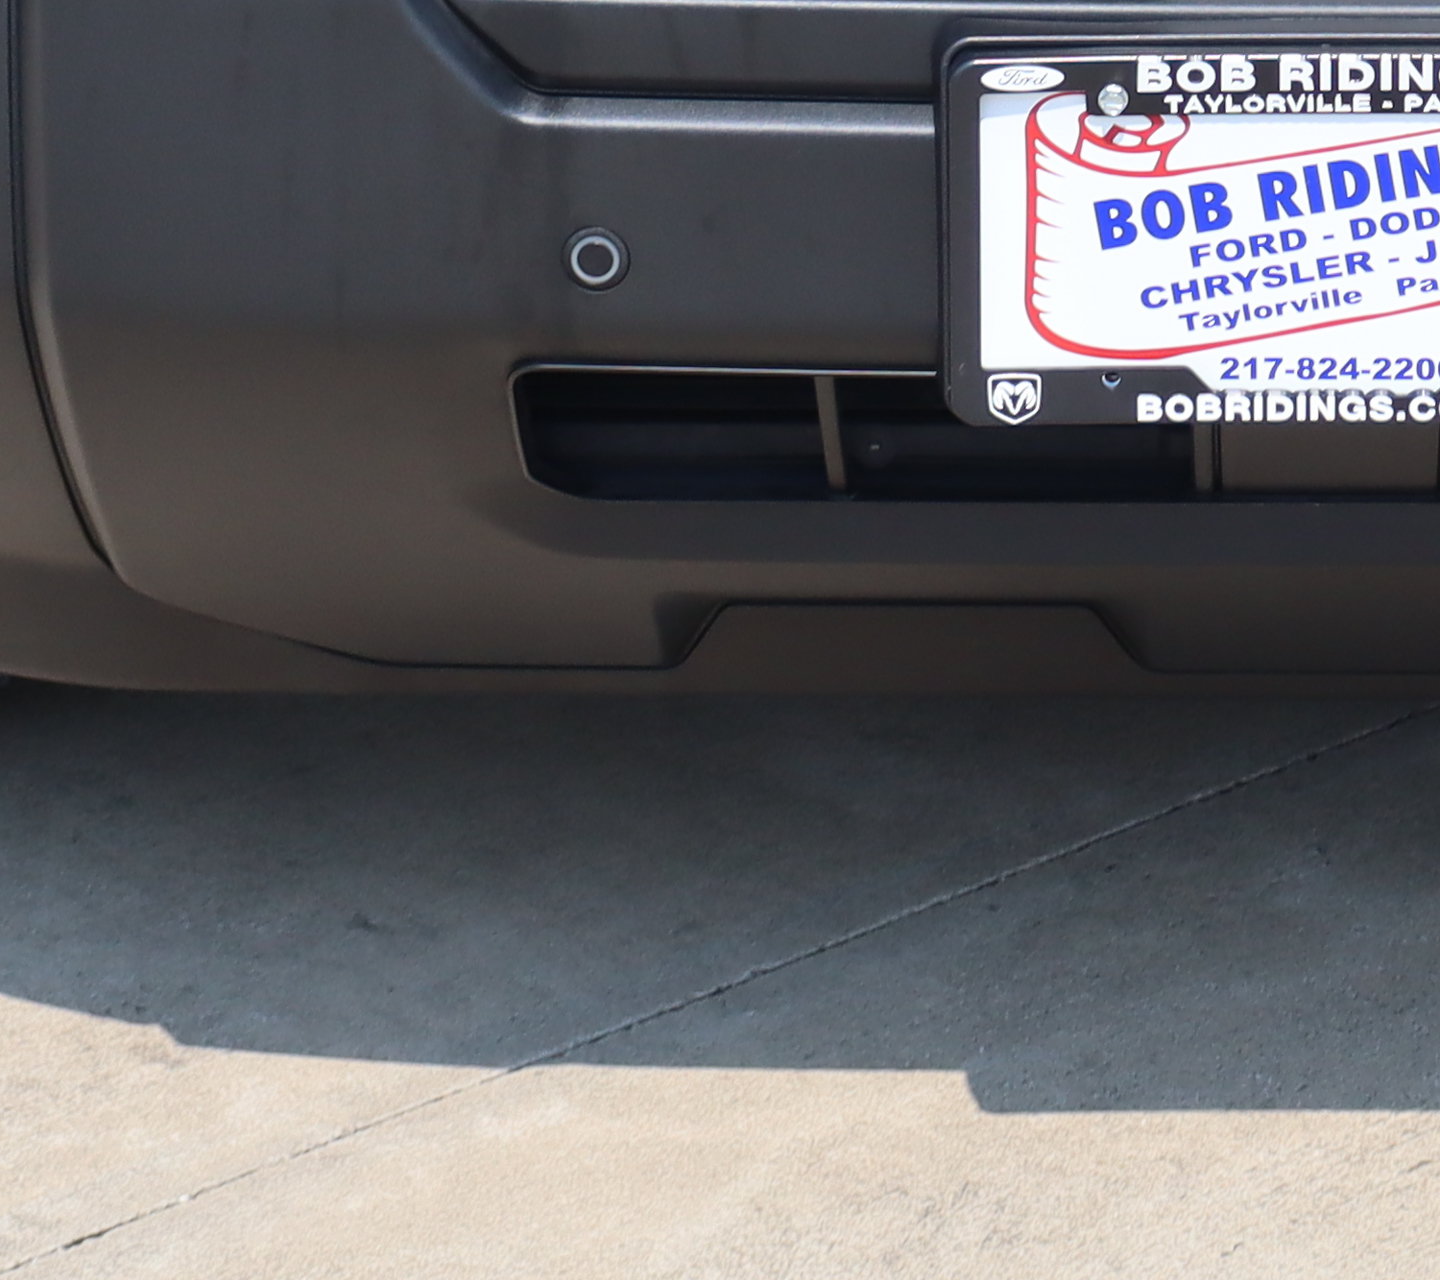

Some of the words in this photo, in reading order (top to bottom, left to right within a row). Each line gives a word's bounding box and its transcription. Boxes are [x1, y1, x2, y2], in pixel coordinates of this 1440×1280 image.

[997, 68, 1048, 87] Ford
[1136, 55, 1257, 93] BOB
[1164, 93, 1372, 114] TAYLORVILLE
[1093, 182, 1233, 250] BOB
[1189, 228, 1307, 268] FORD
[1140, 251, 1374, 309] CHRYSLER
[1178, 290, 1362, 332] Taylorville
